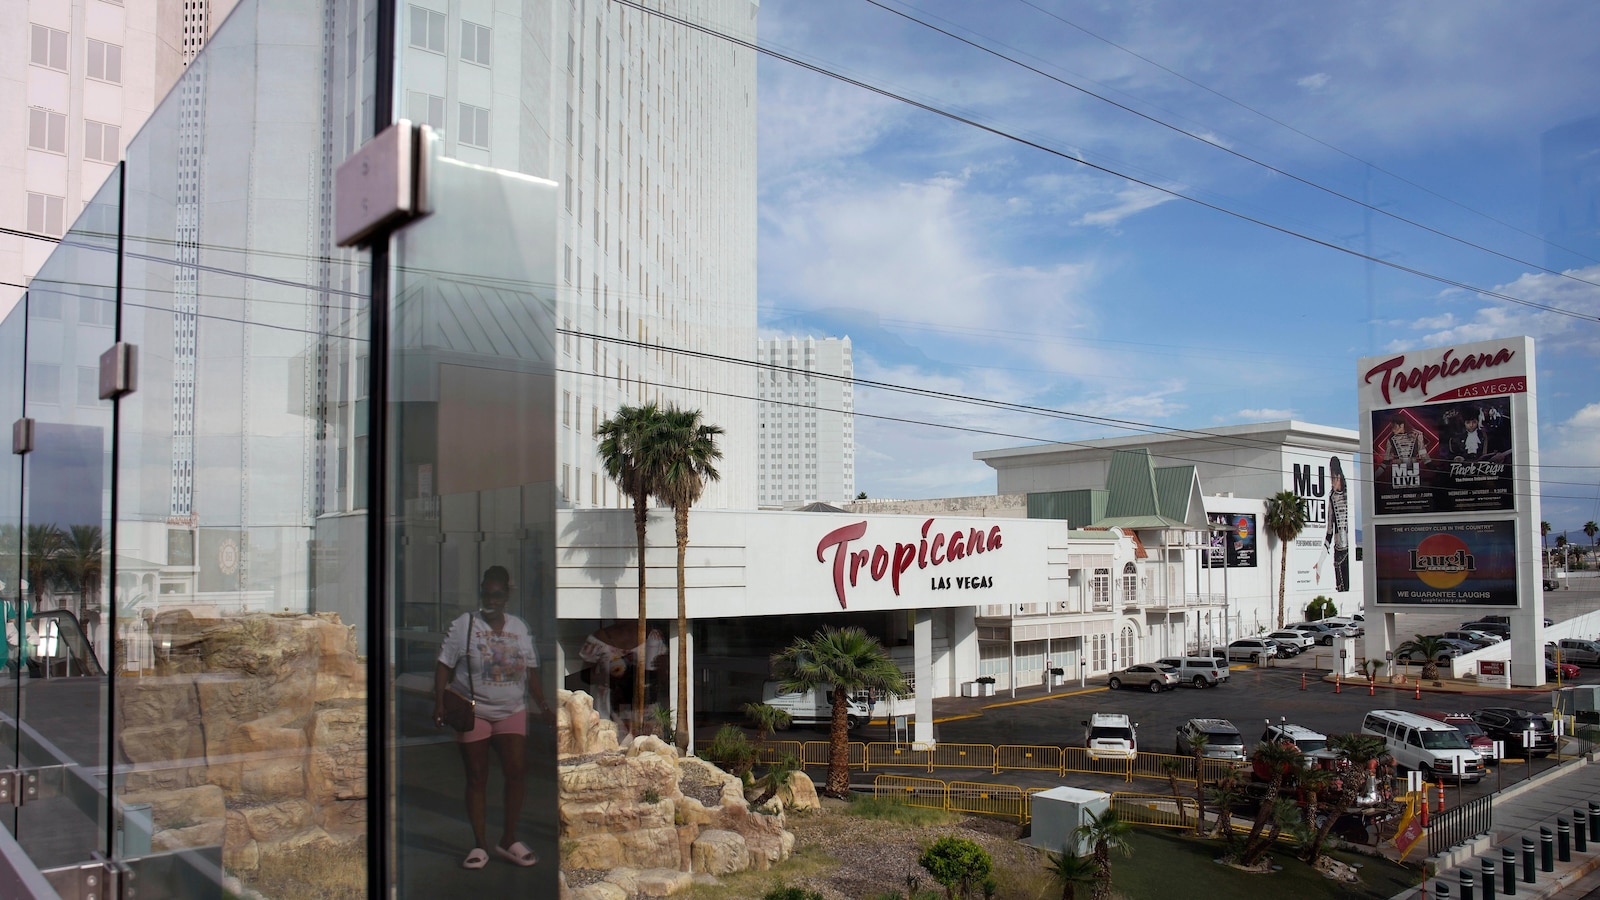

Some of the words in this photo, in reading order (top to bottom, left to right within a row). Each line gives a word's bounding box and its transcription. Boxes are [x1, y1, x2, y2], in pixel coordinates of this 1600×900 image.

[1364, 348, 1515, 404] Tropicana
[1457, 388, 1479, 398] LAS
[1482, 382, 1524, 394] VEGAS
[1294, 463, 1325, 498] MJ
[1391, 462, 1420, 477] MJ
[816, 518, 1003, 610] Tropicana
[1408, 549, 1476, 572] Laugh
[931, 577, 951, 591] LAS
[956, 576, 993, 590] VEGAS
